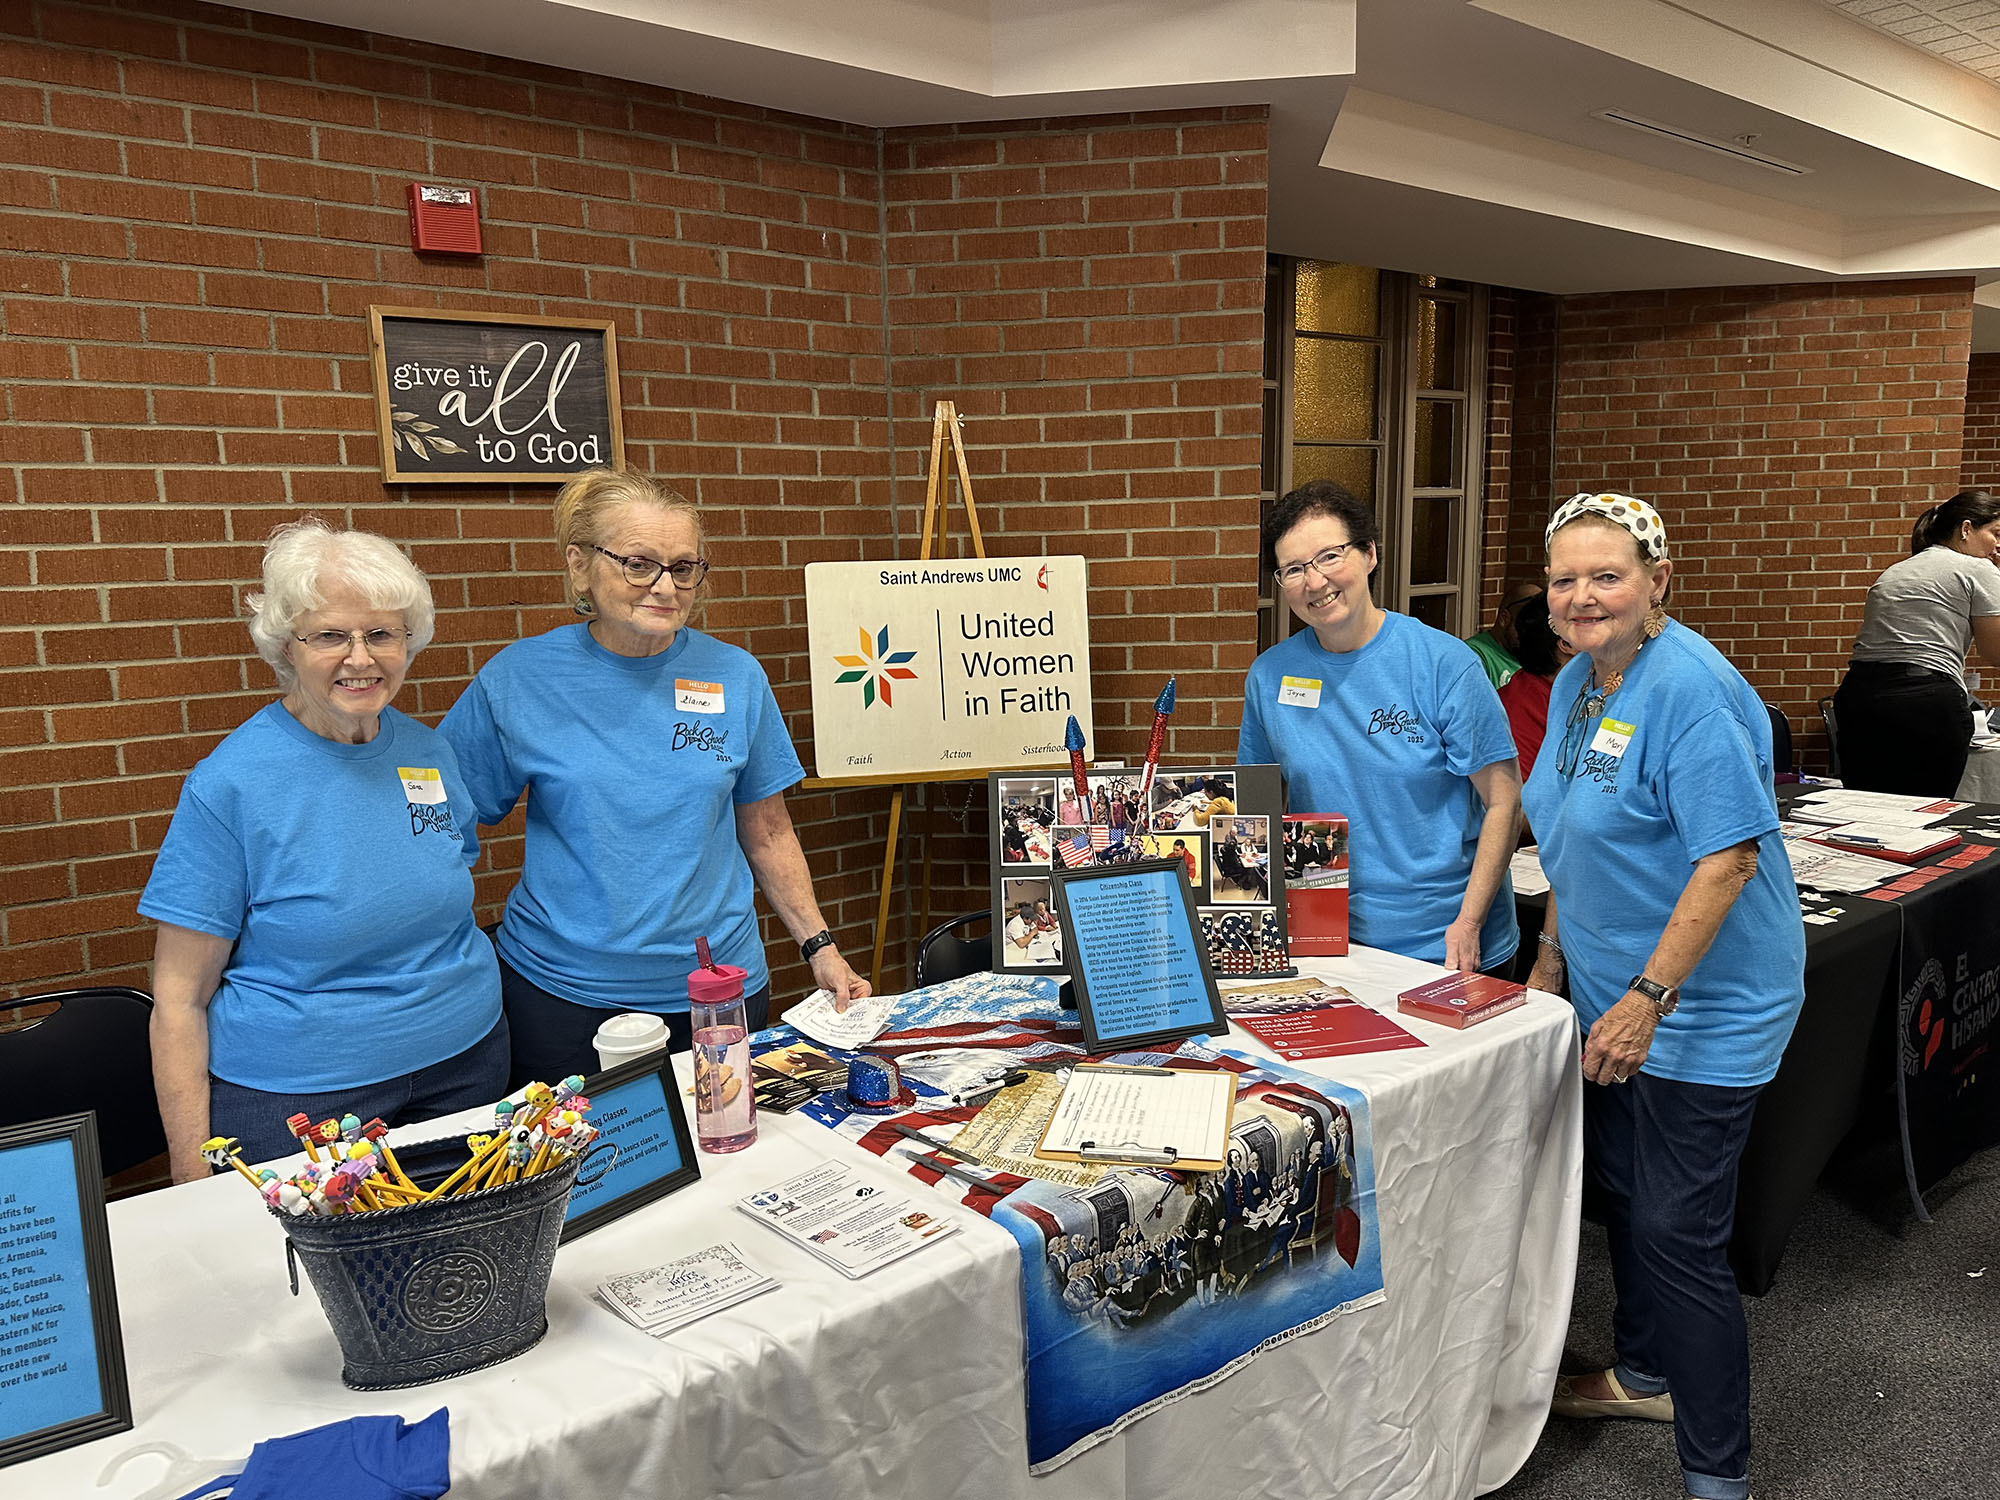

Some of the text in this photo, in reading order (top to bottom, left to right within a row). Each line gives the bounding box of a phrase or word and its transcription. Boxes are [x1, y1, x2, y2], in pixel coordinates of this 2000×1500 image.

[393, 362, 493, 390] give it
[438, 341, 581, 436] all
[475, 432, 604, 464] to God
[880, 567, 1022, 586] Saint Andrews UMC
[960, 610, 1054, 640] United
[960, 652, 1074, 678] Women
[965, 686, 1072, 717] in Faith
[1368, 704, 1420, 735] Back School
[672, 720, 701, 751] Back
[1407, 736, 1424, 744] 2025
[1606, 737, 1624, 752] Mary
[716, 754, 732, 762] 2025
[846, 754, 872, 766] Faith
[940, 750, 972, 760] Action
[1602, 785, 1618, 794] 2025
[1099, 881, 1127, 890] Citizenship
[1083, 934, 1107, 943] Participants
[1130, 929, 1150, 937] knowledge
[1093, 982, 1117, 992] Participants
[1952, 964, 2000, 1016] CENTRO
[1166, 998, 1187, 1007] graduated
[1102, 1024, 1126, 1033] application
[1952, 993, 2000, 1050] HISPANO
[602, 1107, 628, 1122] Classes
[607, 1125, 621, 1136] using
[625, 1116, 644, 1127] sewing
[643, 1106, 665, 1119] machine,
[623, 1142, 640, 1154] basics
[640, 1137, 653, 1146] class
[614, 1157, 635, 1171] projects
[635, 1151, 644, 1160] and
[645, 1145, 658, 1156] using
[4, 1194, 16, 1204] all
[24, 1205, 36, 1214] for
[10, 1216, 55, 1232] have been
[16, 1230, 57, 1246] traveling
[6, 1247, 48, 1263] Armenia,
[12, 1266, 36, 1277] Peru,
[12, 1273, 64, 1292] Guatemala,
[24, 1292, 49, 1304] Costa
[10, 1312, 29, 1324] New
[32, 1303, 66, 1317] Mexico,
[32, 1322, 44, 1333] NC
[46, 1320, 59, 1329] for
[14, 1335, 58, 1353] members
[0, 1352, 50, 1372] create new
[1, 1361, 68, 1388] over the world
